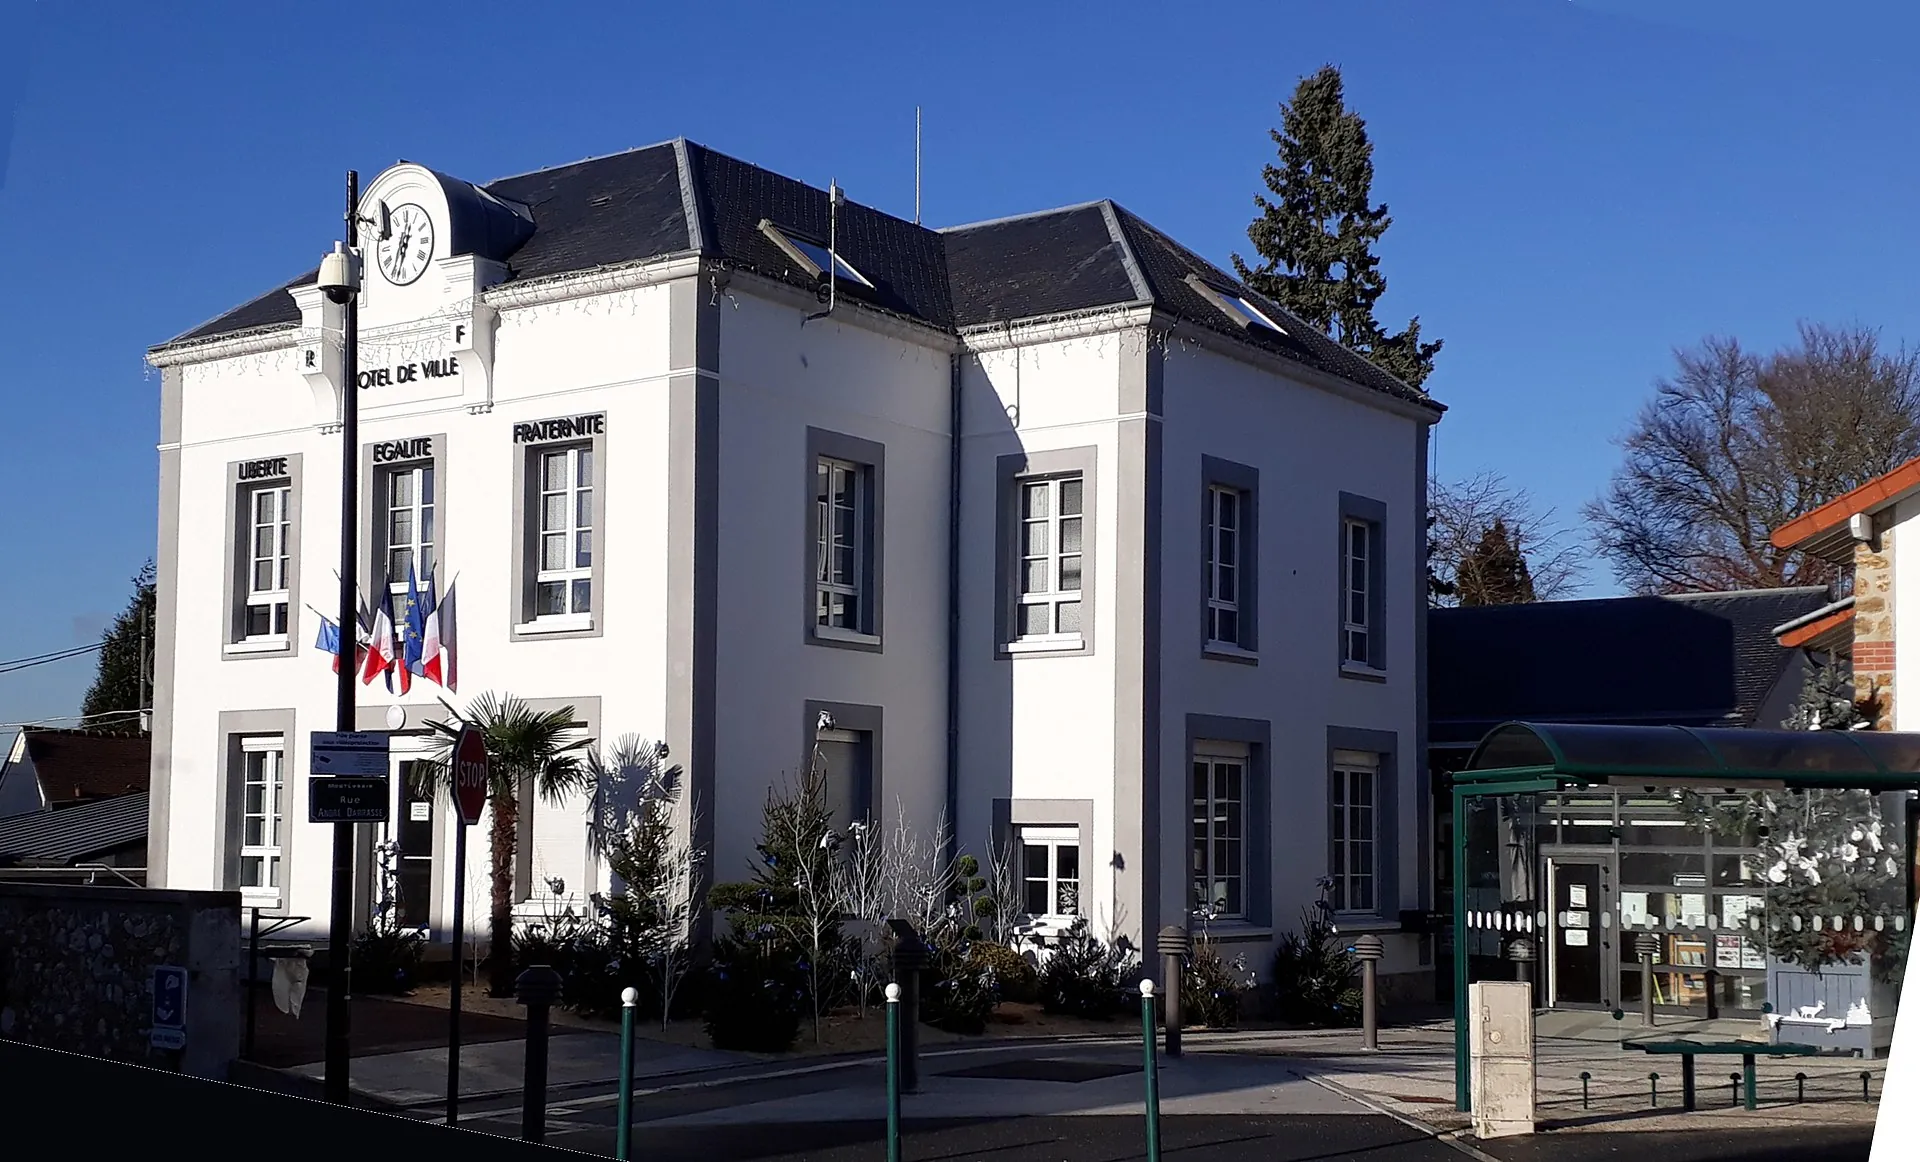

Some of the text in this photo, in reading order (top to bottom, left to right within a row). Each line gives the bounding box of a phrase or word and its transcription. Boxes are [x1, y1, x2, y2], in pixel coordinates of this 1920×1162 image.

[456, 324, 465, 344] F
[305, 350, 316, 367] R
[356, 357, 459, 389] OTEL DE VILLE
[513, 414, 604, 444] FRATERNITE
[373, 437, 432, 462] EGALITE
[239, 457, 288, 480] LIBERTE
[459, 760, 485, 789] STOP
[340, 795, 361, 804] Rue
